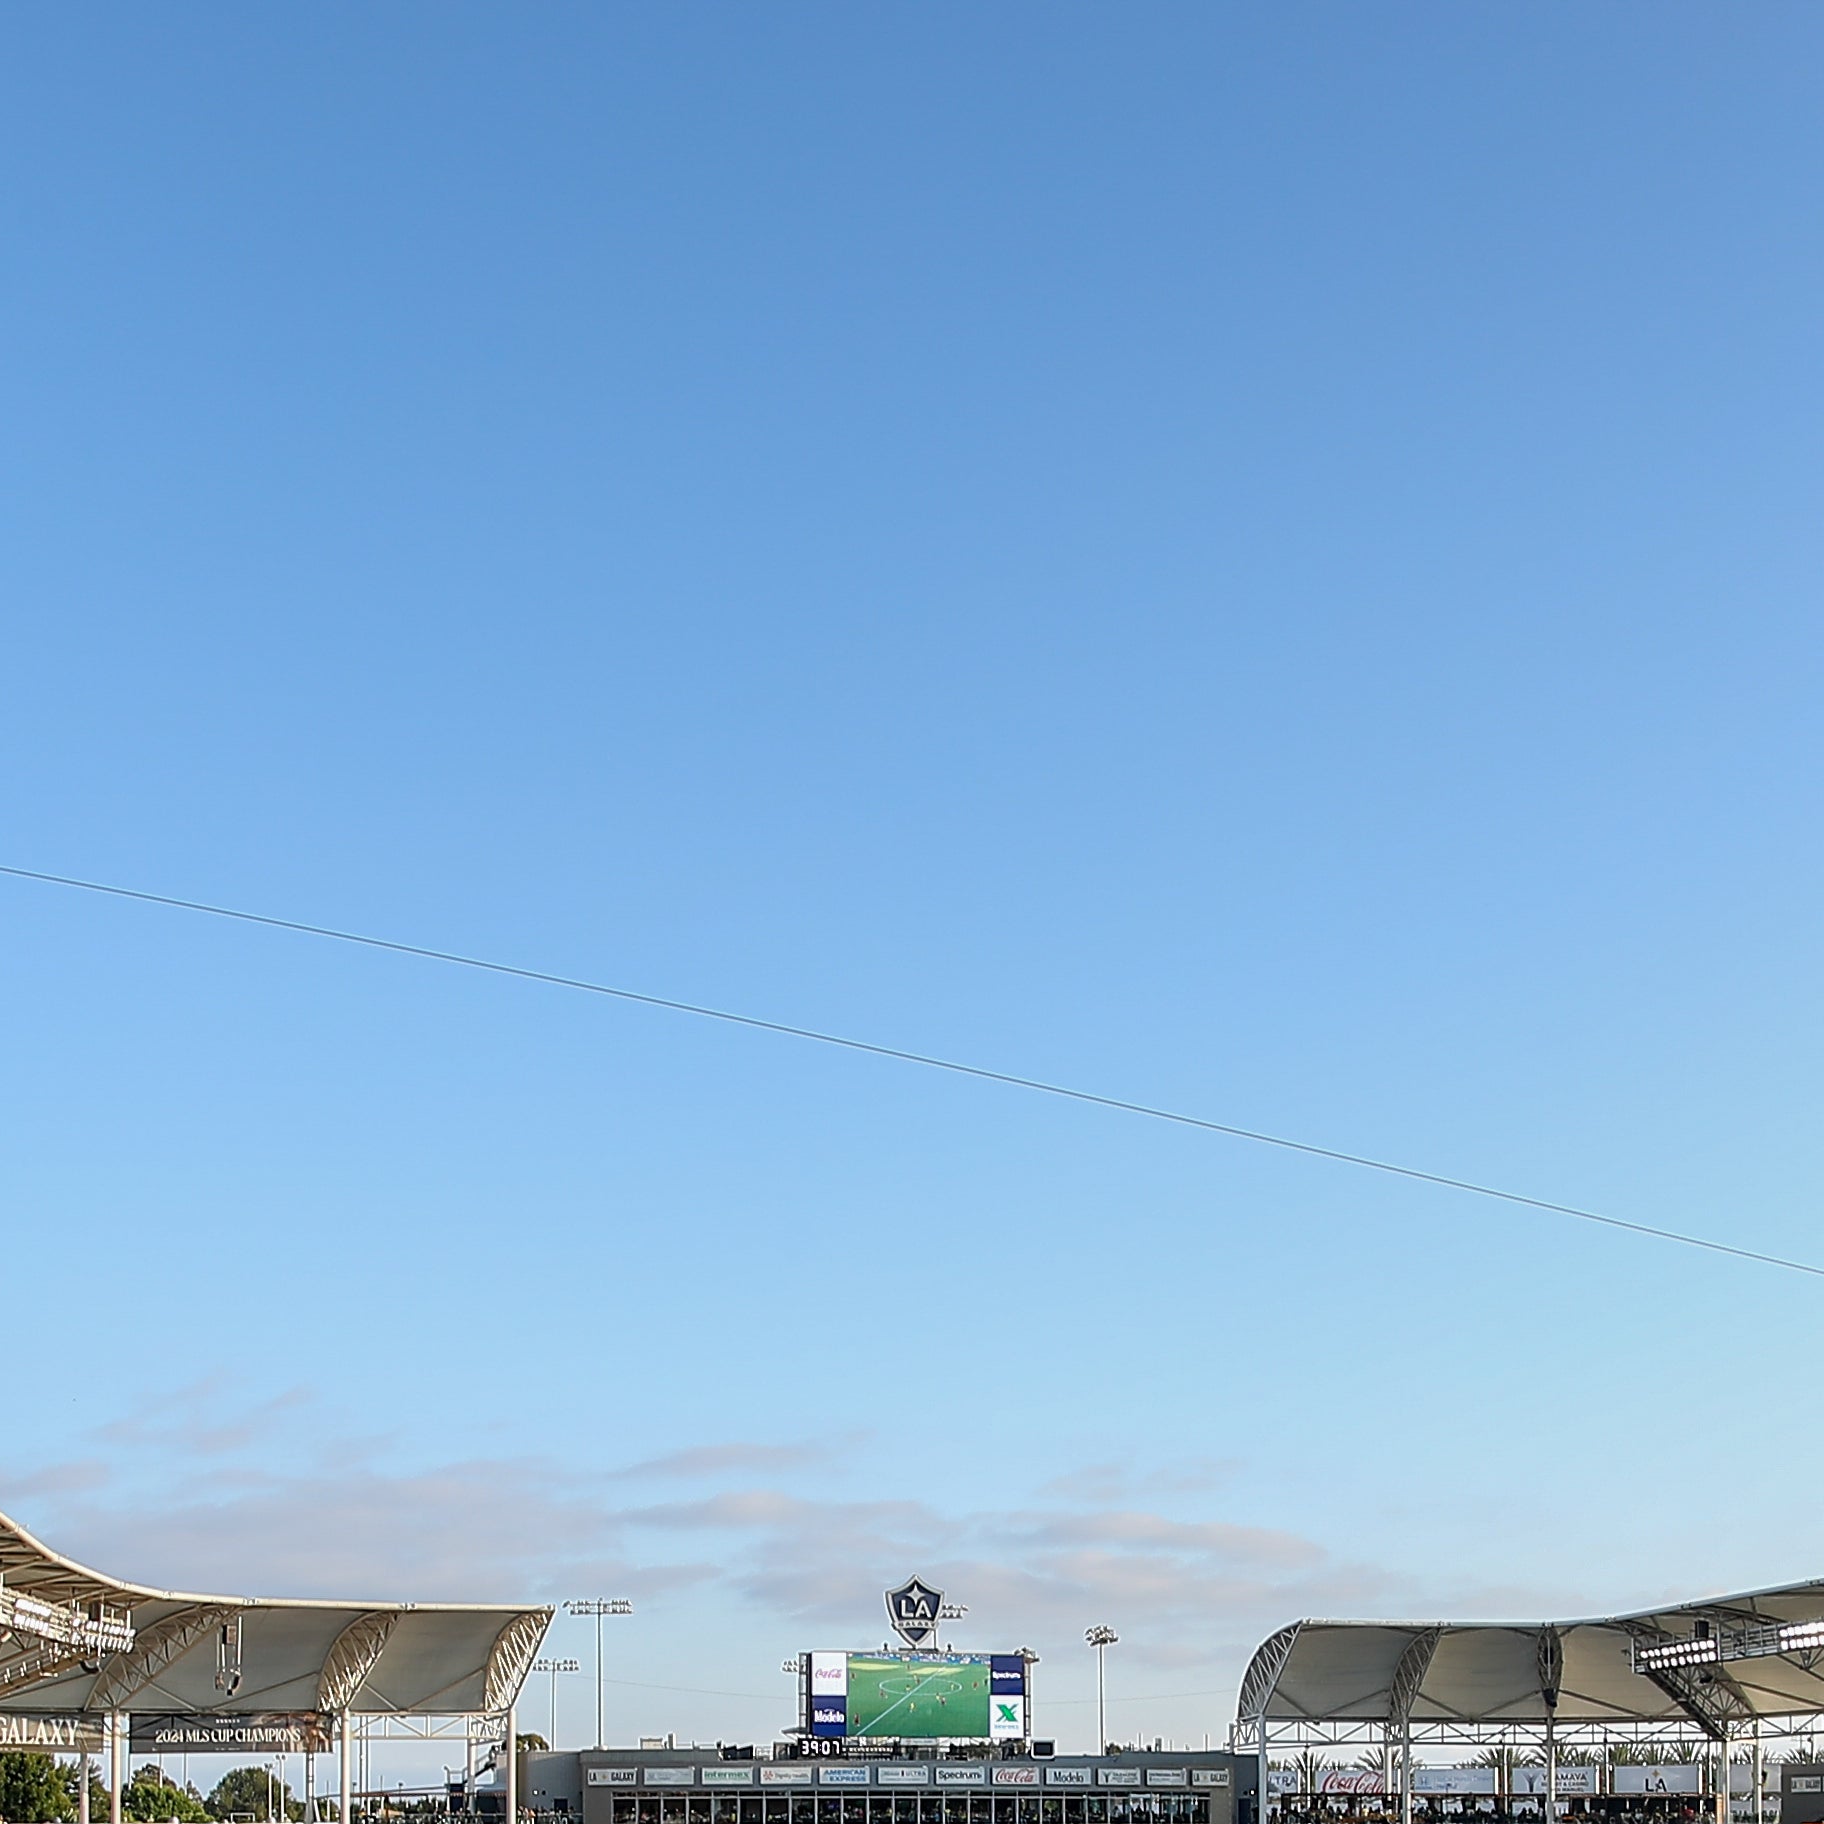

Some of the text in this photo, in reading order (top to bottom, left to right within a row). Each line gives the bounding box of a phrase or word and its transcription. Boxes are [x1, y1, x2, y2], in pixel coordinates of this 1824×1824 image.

[900, 1600, 932, 1617] LA
[814, 1709, 845, 1723] Modelo
[156, 1727, 301, 1743] 2024 MLS CUP CHAMPIONS
[801, 1740, 841, 1755] 39:07
[589, 1772, 597, 1781] LA
[611, 1772, 634, 1781] GALAXY
[938, 1771, 979, 1780] Spectrum
[996, 1768, 1034, 1782] Coca-Cola
[1053, 1771, 1084, 1782] Modelo
[1645, 1778, 1667, 1792] LA
